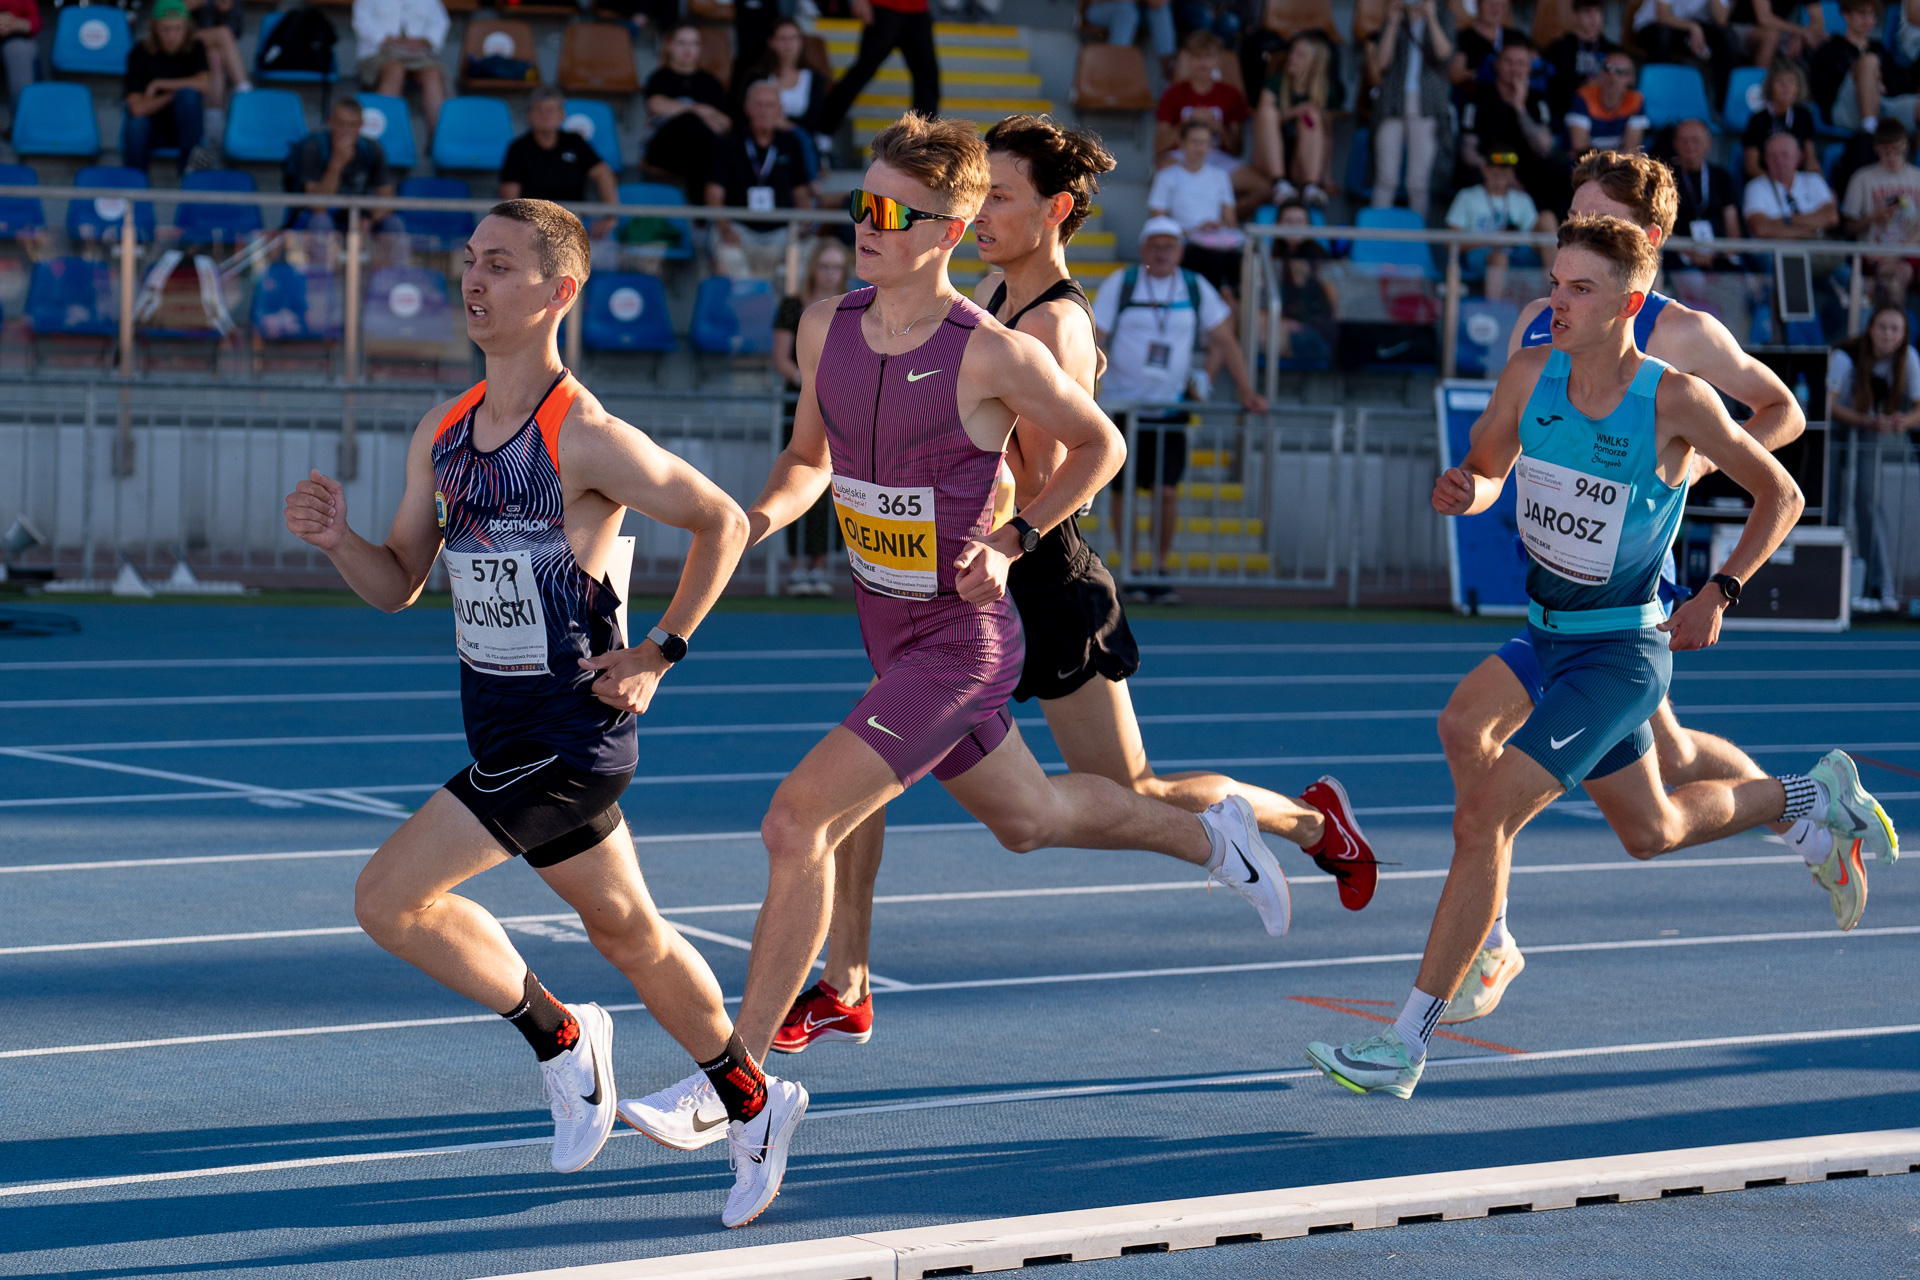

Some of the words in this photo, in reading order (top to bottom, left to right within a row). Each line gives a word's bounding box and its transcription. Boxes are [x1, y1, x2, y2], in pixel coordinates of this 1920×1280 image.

[1593, 443, 1627, 458] Pomorze
[1596, 432, 1629, 448] WMLKS
[1574, 478, 1617, 506] 940
[877, 493, 922, 516] 365
[489, 519, 548, 532] DECATHLON
[1524, 498, 1607, 545] JAROSZ
[844, 517, 928, 559] OLEJNIK
[472, 558, 518, 582] 579
